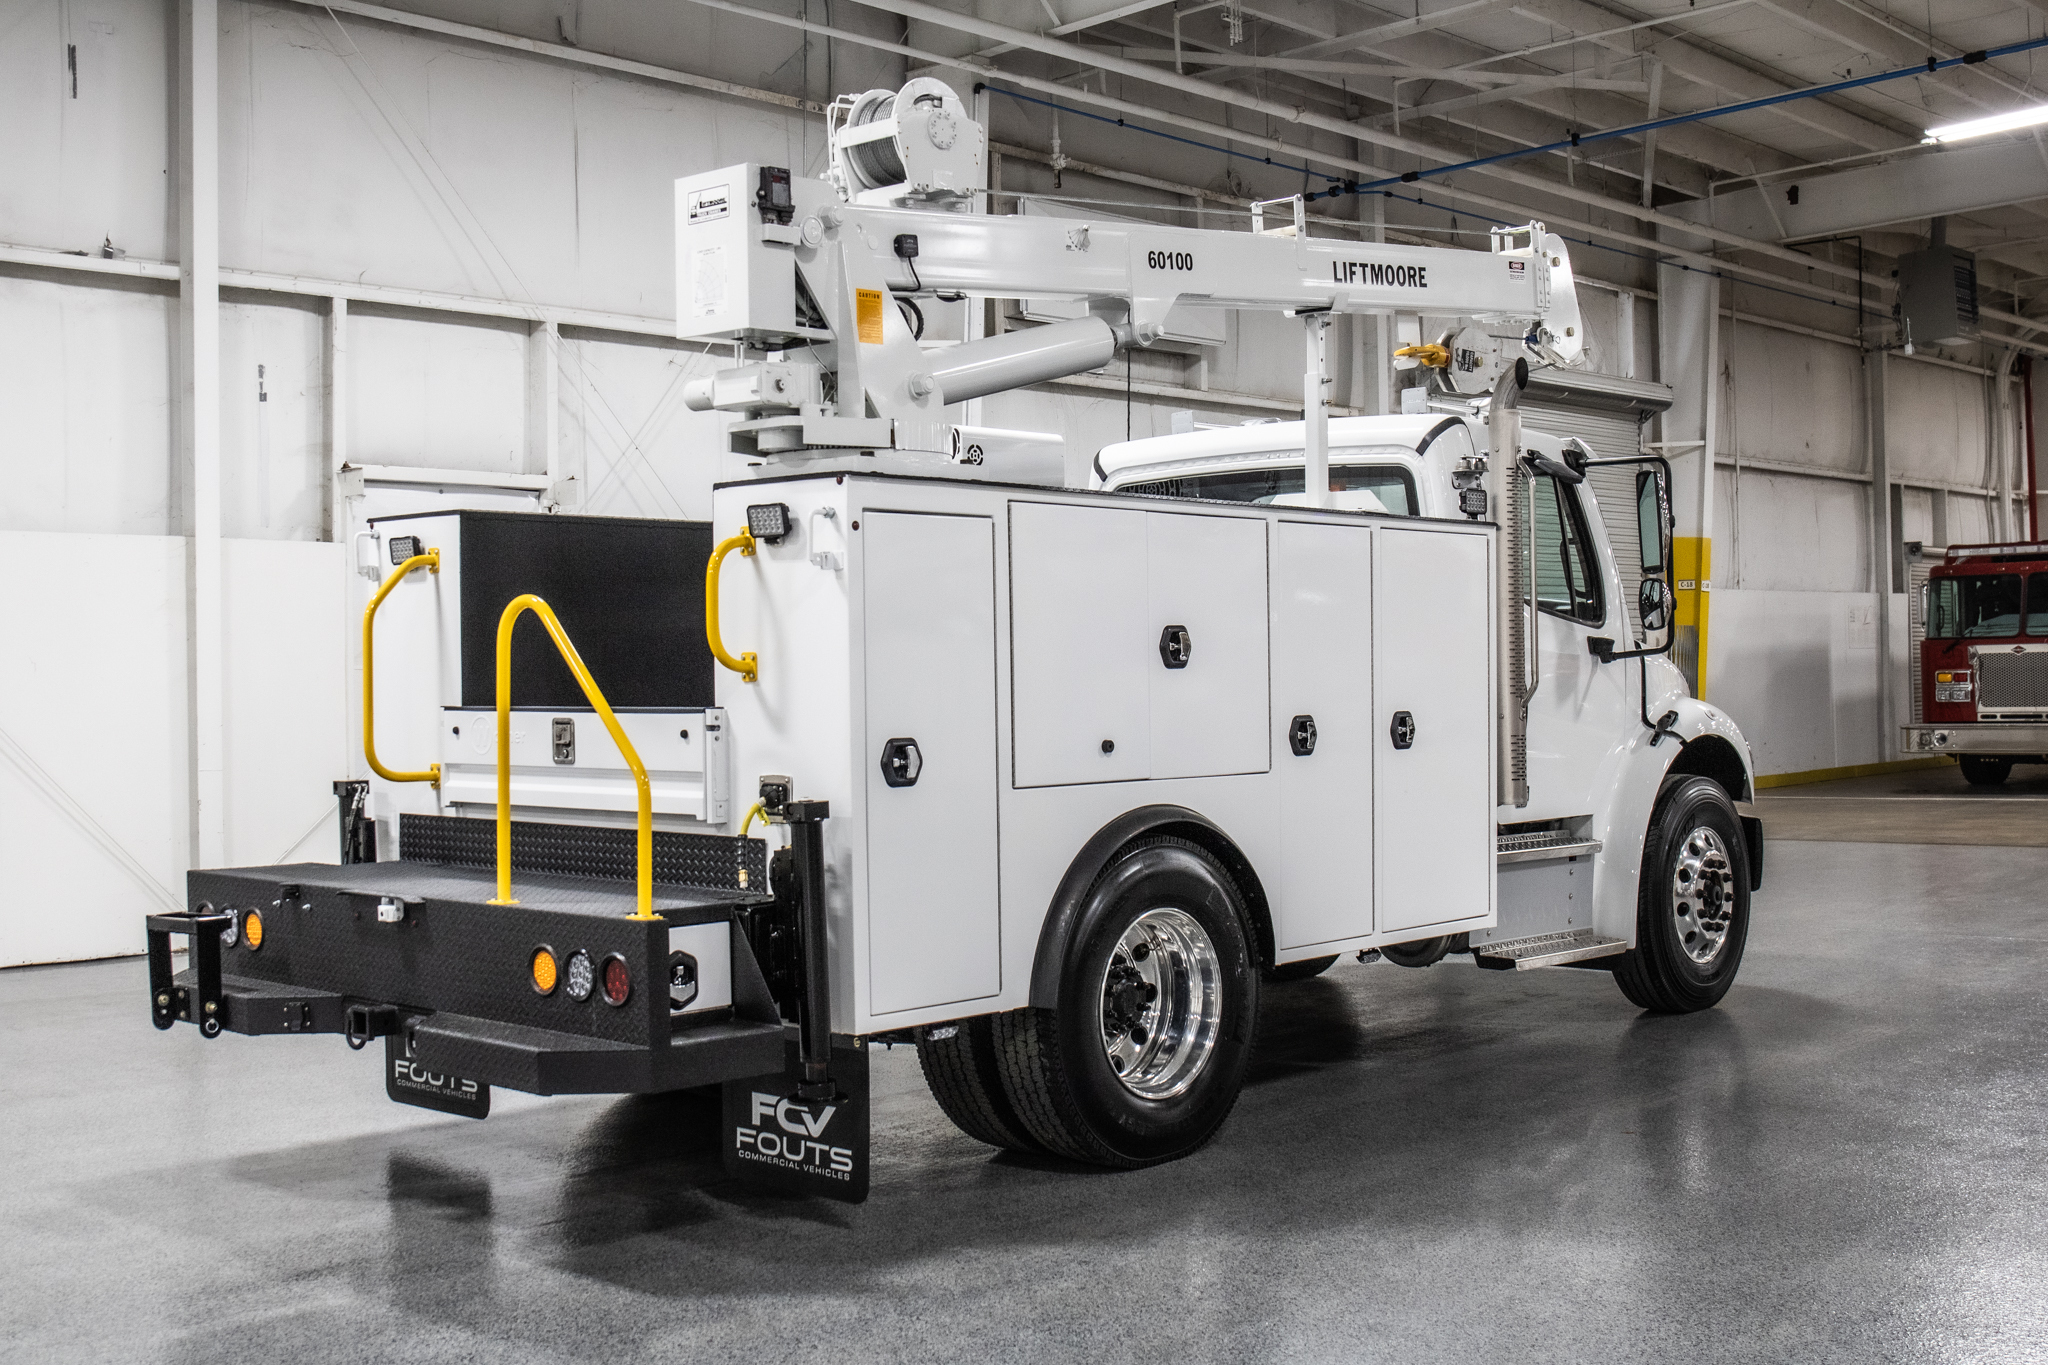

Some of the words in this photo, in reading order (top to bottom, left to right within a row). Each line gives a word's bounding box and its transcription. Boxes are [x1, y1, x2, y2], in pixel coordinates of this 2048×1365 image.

[1148, 250, 1193, 271] 60100
[1332, 260, 1428, 288] LIFTMOORE
[858, 291, 880, 300] CAUTION
[396, 1078, 441, 1094] COMMERCIAL
[442, 1087, 477, 1101] VEHICLES
[751, 1090, 837, 1138] FCV
[736, 1126, 853, 1172] FOUTS
[738, 1149, 800, 1170] COMMERCIAL
[802, 1163, 851, 1181] VEHICLES
